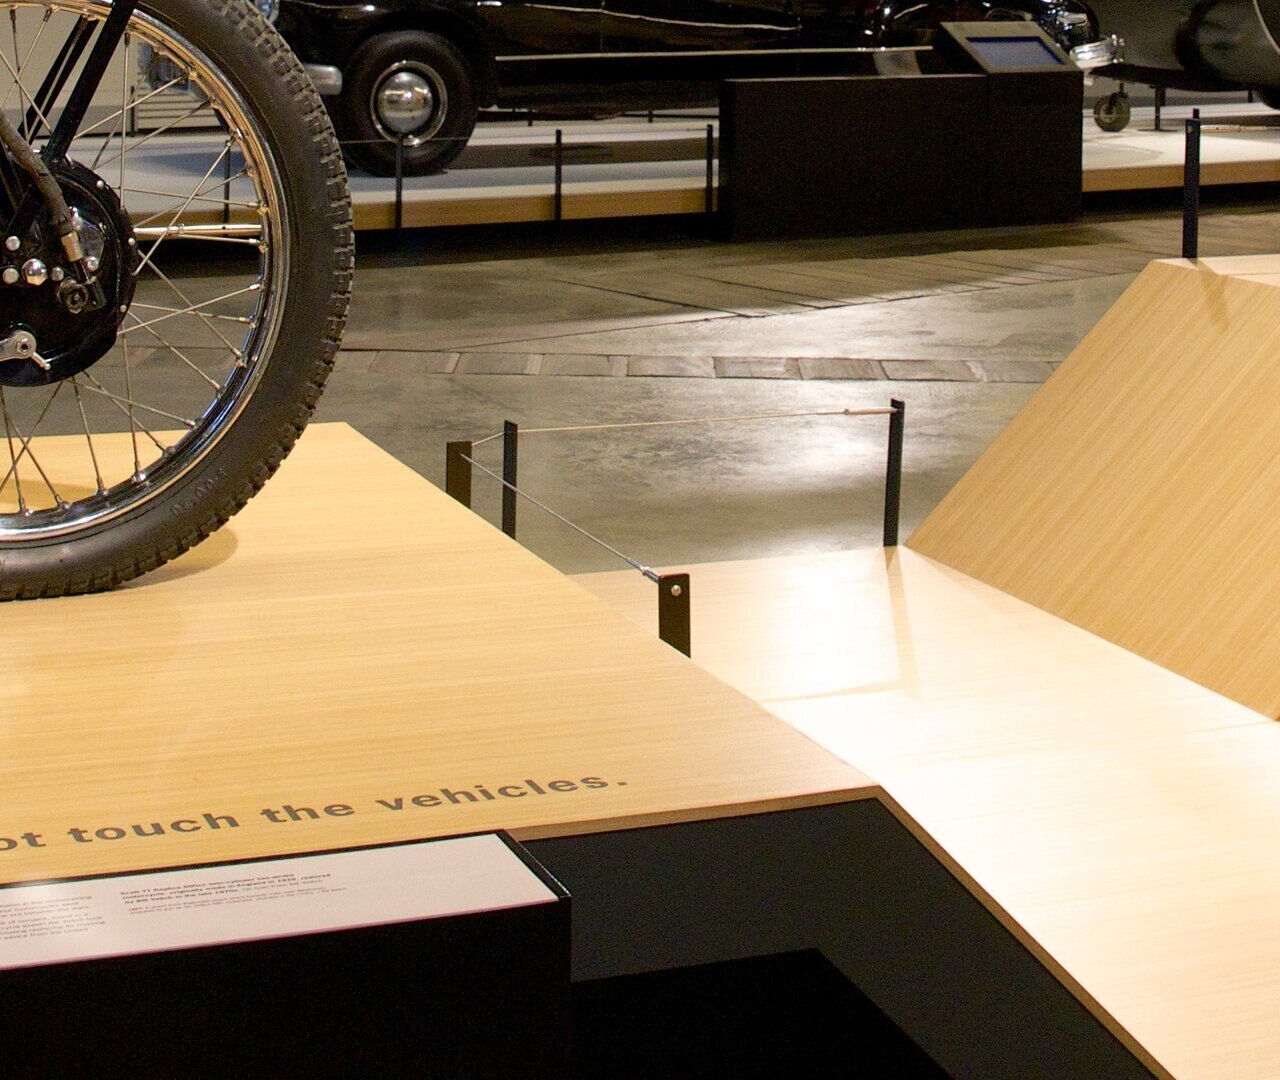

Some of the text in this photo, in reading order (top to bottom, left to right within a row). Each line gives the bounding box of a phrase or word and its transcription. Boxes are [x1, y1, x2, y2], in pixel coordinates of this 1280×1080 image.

[67, 813, 240, 843] touch
[260, 804, 356, 824] the
[375, 776, 629, 812] vehicles.
